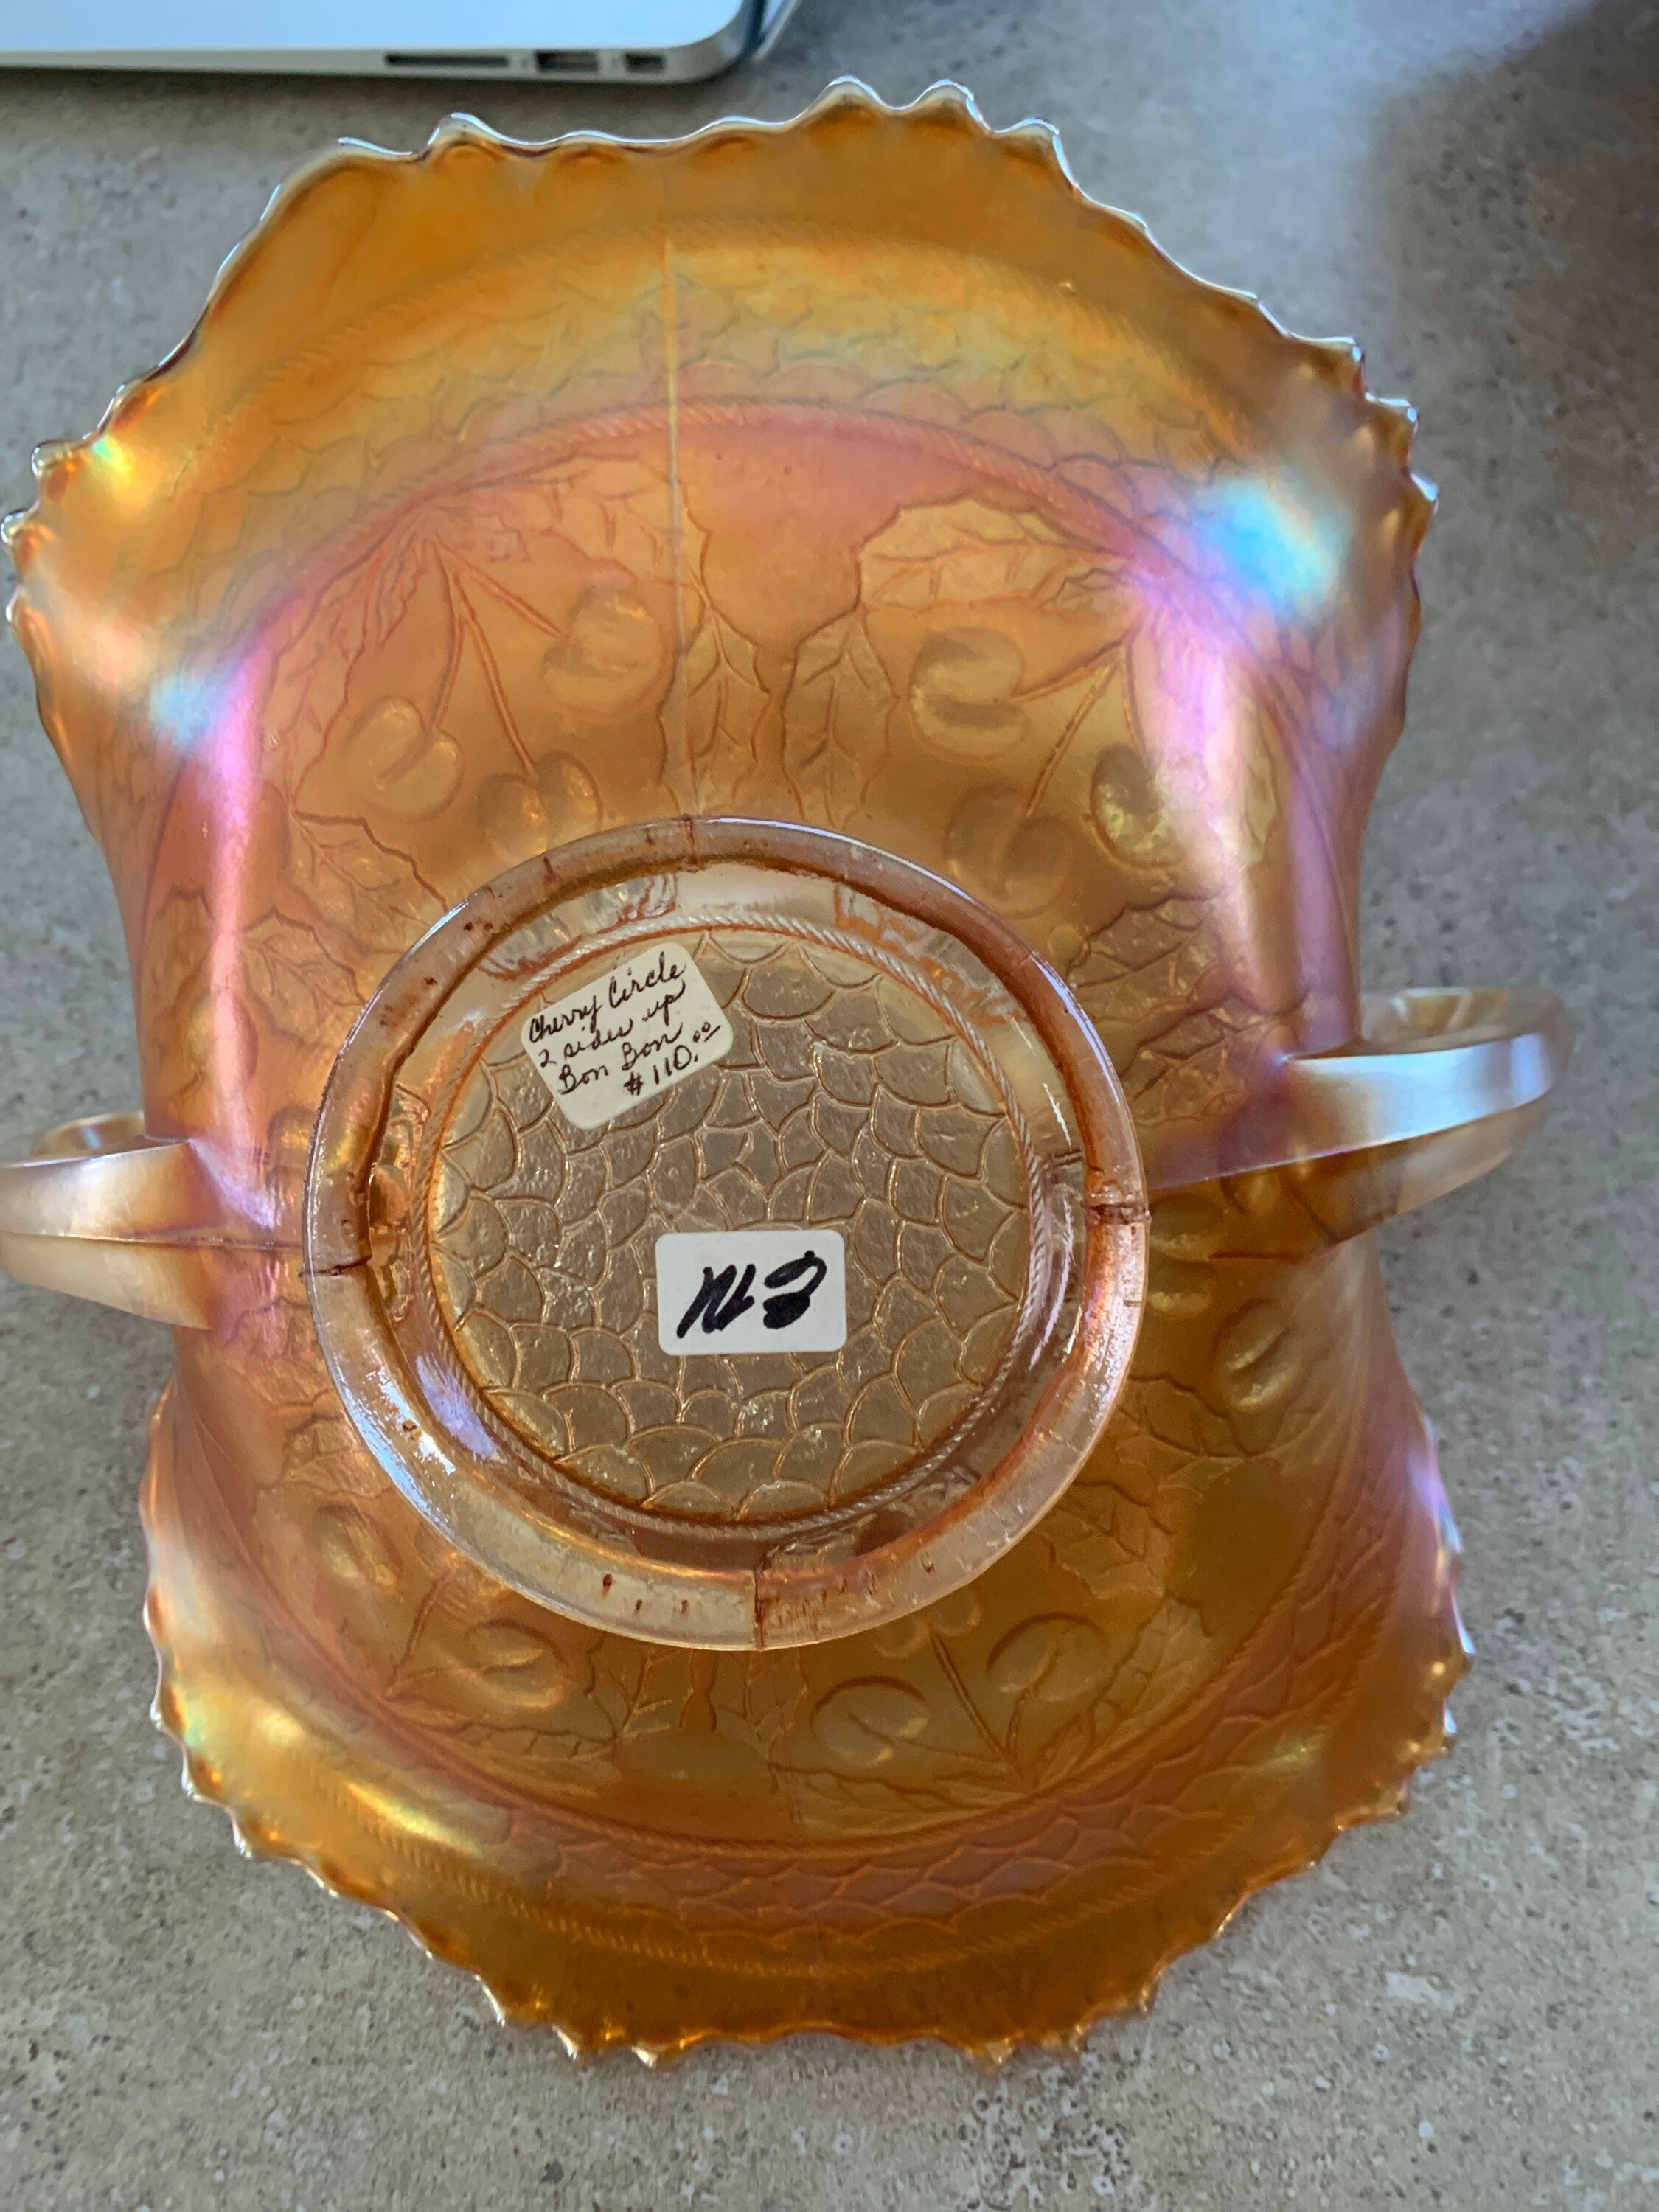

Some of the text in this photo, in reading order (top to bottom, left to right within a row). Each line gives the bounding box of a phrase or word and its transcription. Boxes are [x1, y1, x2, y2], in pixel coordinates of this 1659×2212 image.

[529, 951, 686, 1043] Cherry Circle
[539, 978, 686, 1068] 2 sides up
[558, 1022, 683, 1095] Bon Bon
